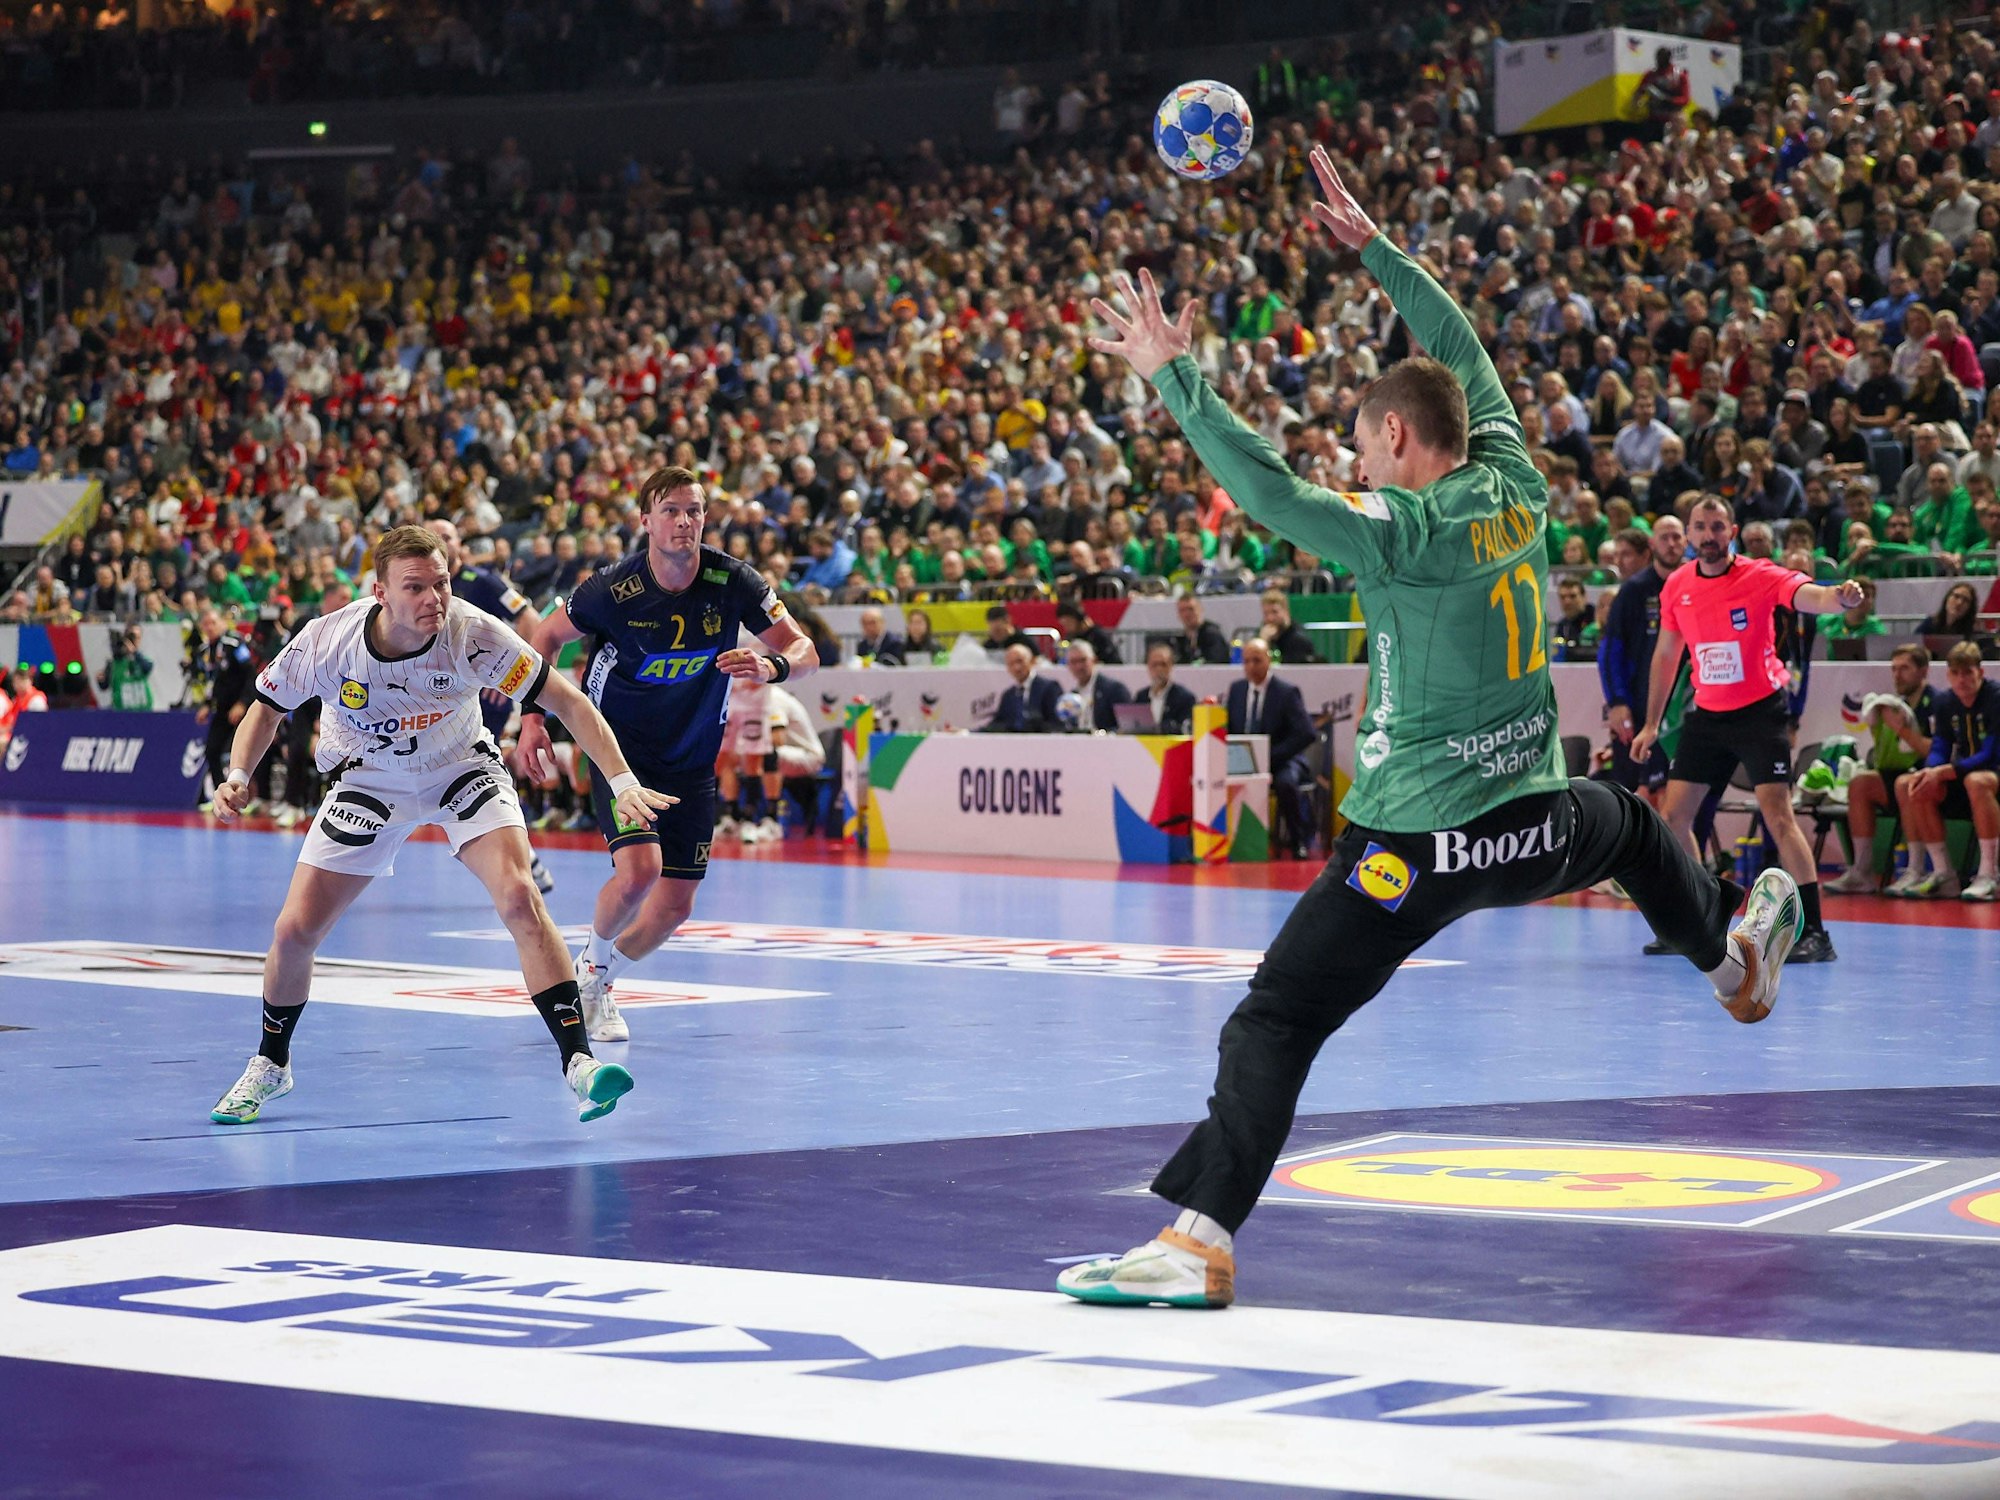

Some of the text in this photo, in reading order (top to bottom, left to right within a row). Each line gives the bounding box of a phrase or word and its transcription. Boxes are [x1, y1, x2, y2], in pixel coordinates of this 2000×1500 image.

[613, 577, 642, 600] XL
[627, 620, 653, 628] CRAFT
[670, 614, 686, 650] 2
[1490, 562, 1546, 681] 12
[586, 642, 615, 709] Gjensidi
[641, 655, 710, 679] ATG
[1702, 660, 1737, 681] Country
[61, 737, 99, 770] HERE
[106, 738, 144, 773] PLAY
[960, 767, 1062, 816] COLOGNE
[327, 805, 384, 832] HARTING
[222, 1260, 667, 1304] TYRES
[17, 1275, 2000, 1466] FALKEN
